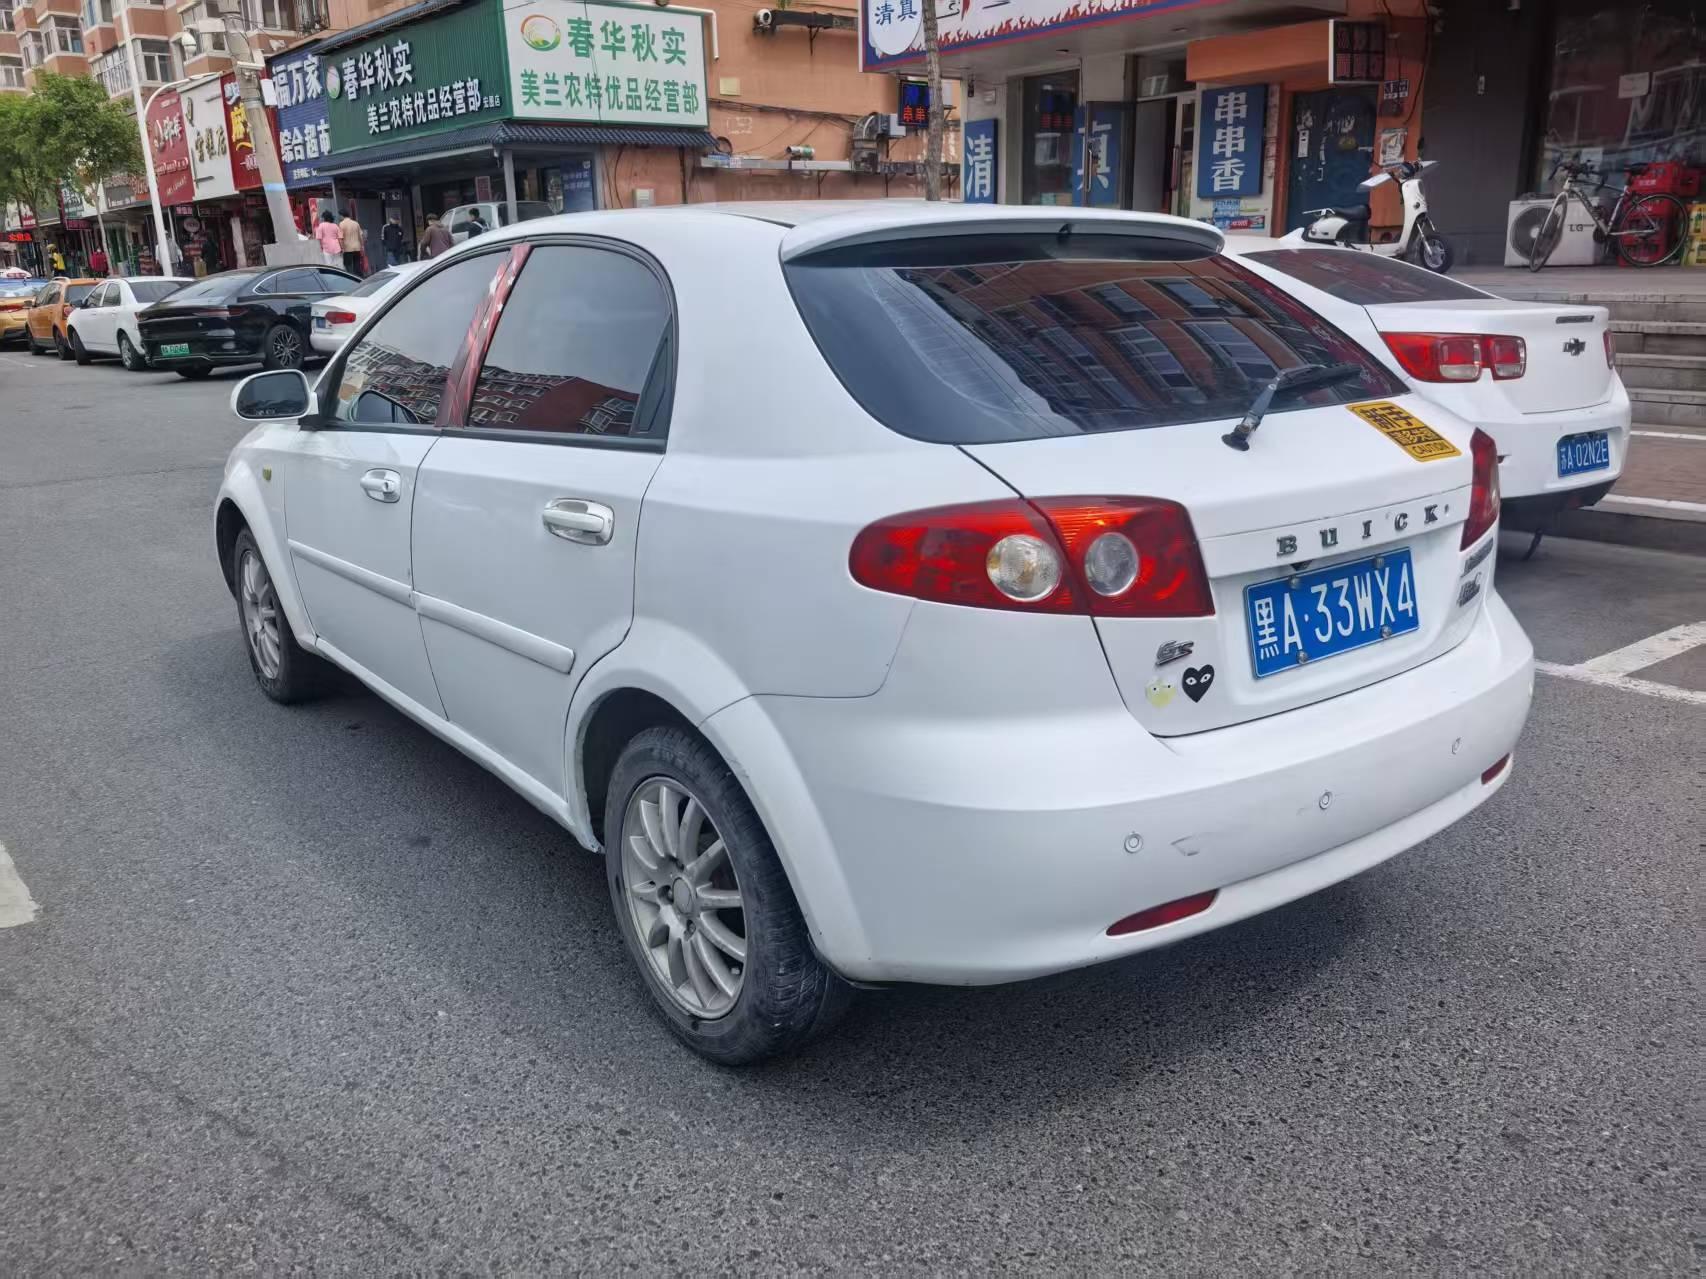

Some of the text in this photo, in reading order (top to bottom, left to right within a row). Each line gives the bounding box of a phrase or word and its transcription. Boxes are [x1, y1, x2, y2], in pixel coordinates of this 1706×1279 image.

[874, 0, 918, 25] 清真
[567, 17, 687, 66] 春华秋实
[273, 54, 322, 109] 福万家
[342, 39, 413, 101] 春华秋实
[520, 68, 699, 115] 美兰农特优品经营部
[367, 76, 481, 135] 美兰农特优品经营部
[279, 118, 332, 163] 综合超市
[966, 133, 993, 199] 清
[1211, 92, 1249, 192] 串串香
[1277, 503, 1438, 556] BUICK
